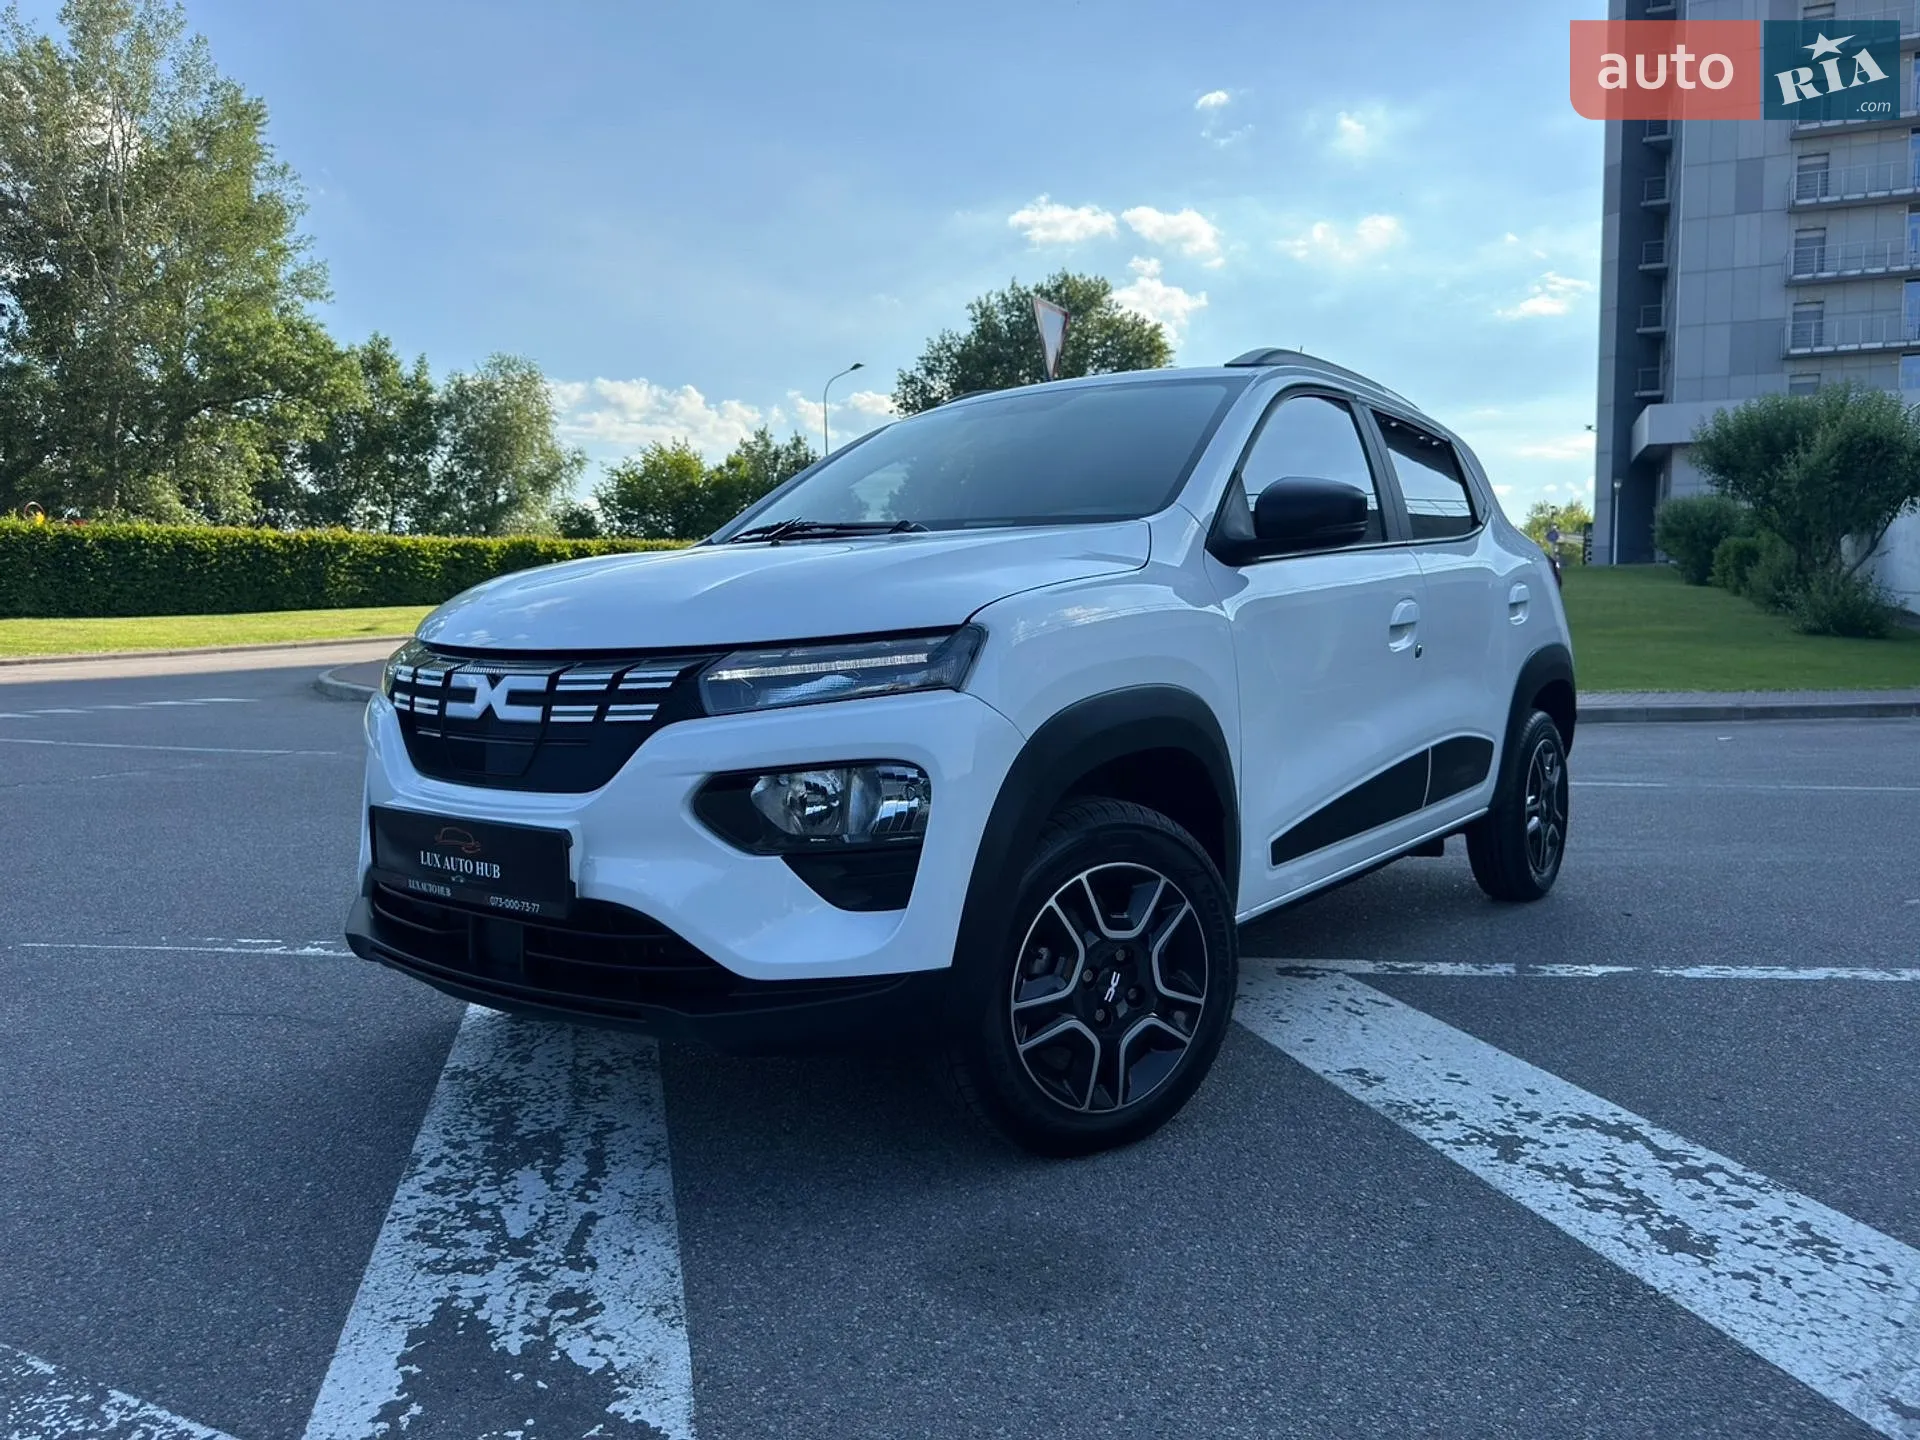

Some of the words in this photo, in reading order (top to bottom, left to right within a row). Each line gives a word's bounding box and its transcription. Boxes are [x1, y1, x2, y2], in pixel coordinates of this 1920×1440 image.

[419, 850, 441, 868] LUX
[442, 855, 474, 874] AUTO
[475, 861, 501, 879] HUB
